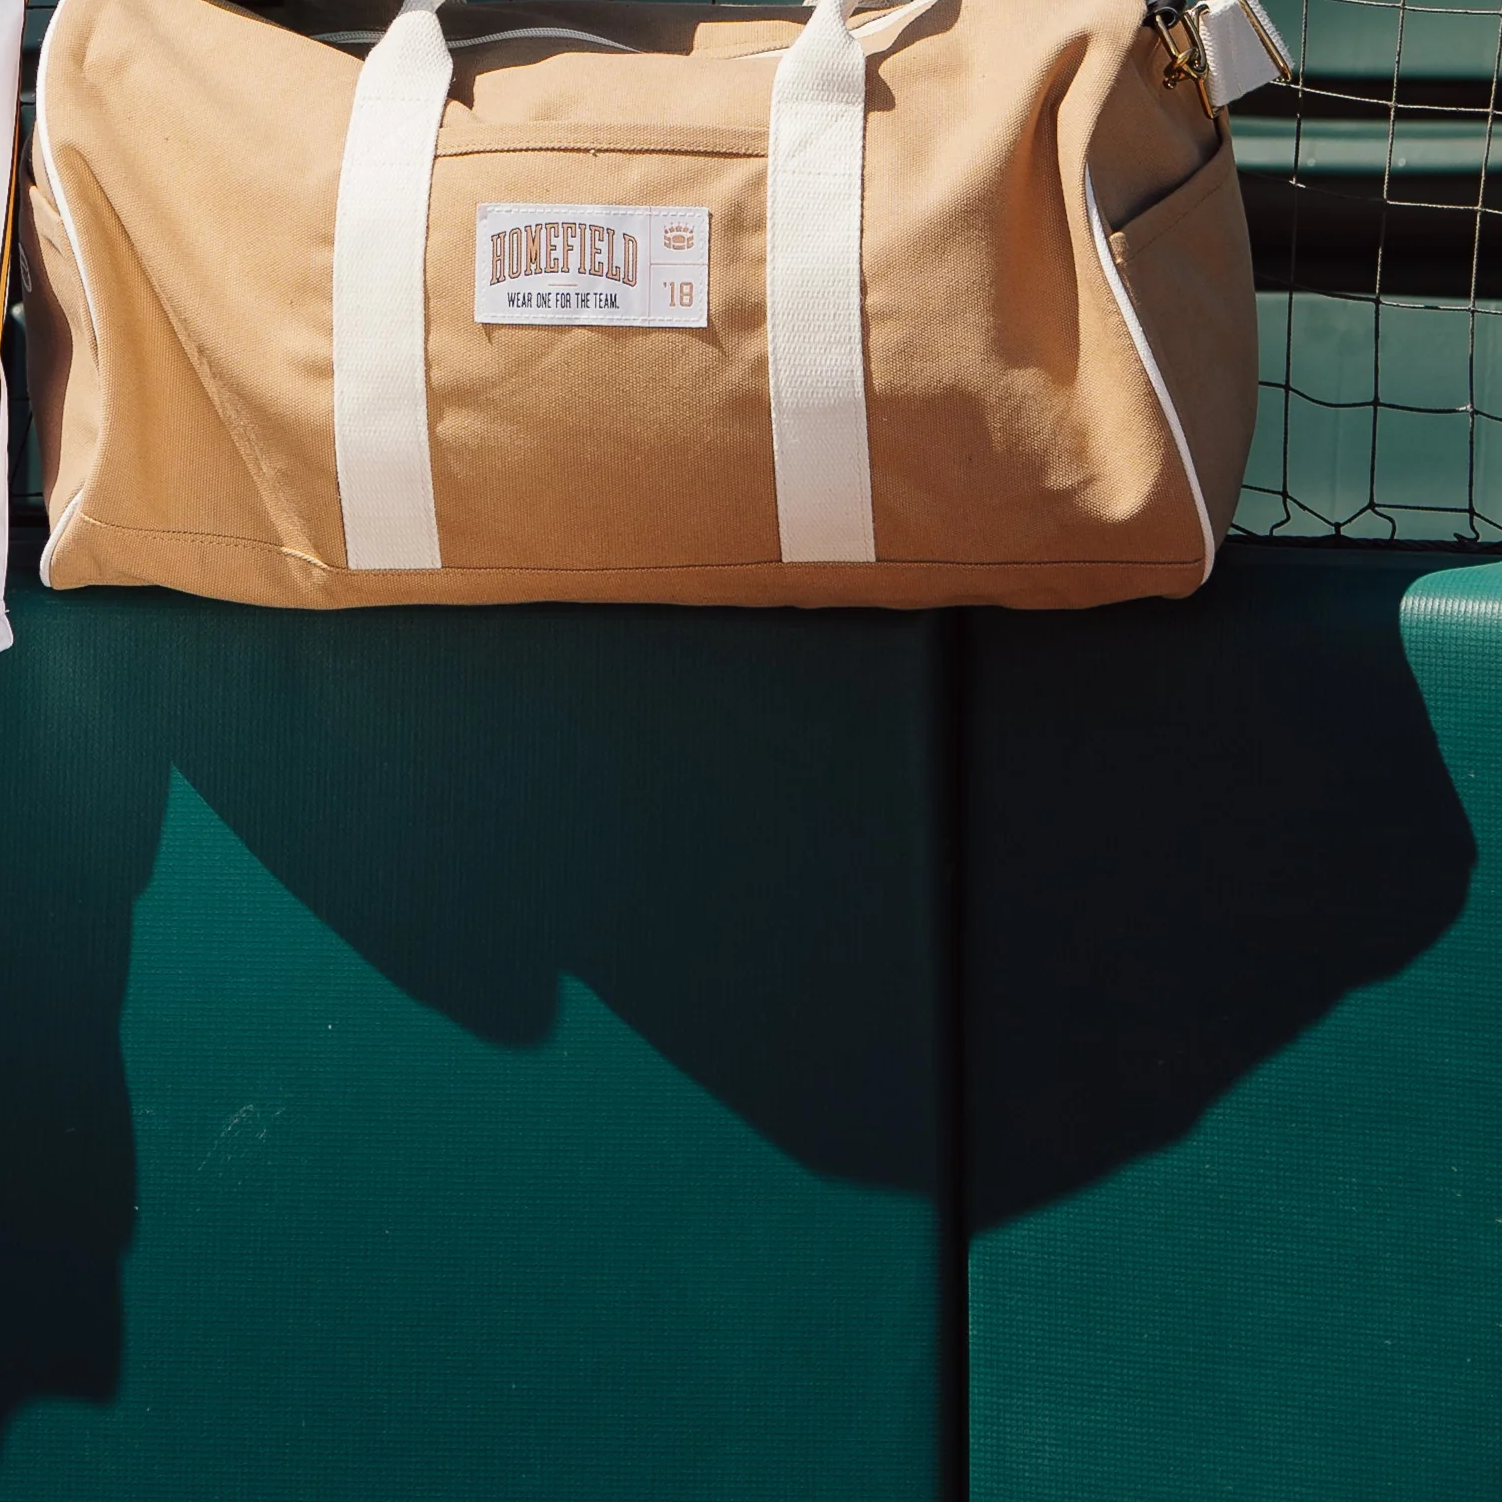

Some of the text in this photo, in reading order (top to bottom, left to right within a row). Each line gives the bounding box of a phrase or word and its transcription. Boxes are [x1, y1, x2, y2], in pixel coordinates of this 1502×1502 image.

[489, 221, 638, 288] HOMEFIELD
[507, 292, 620, 310] WEAR ONE FOR THE TEAM.
